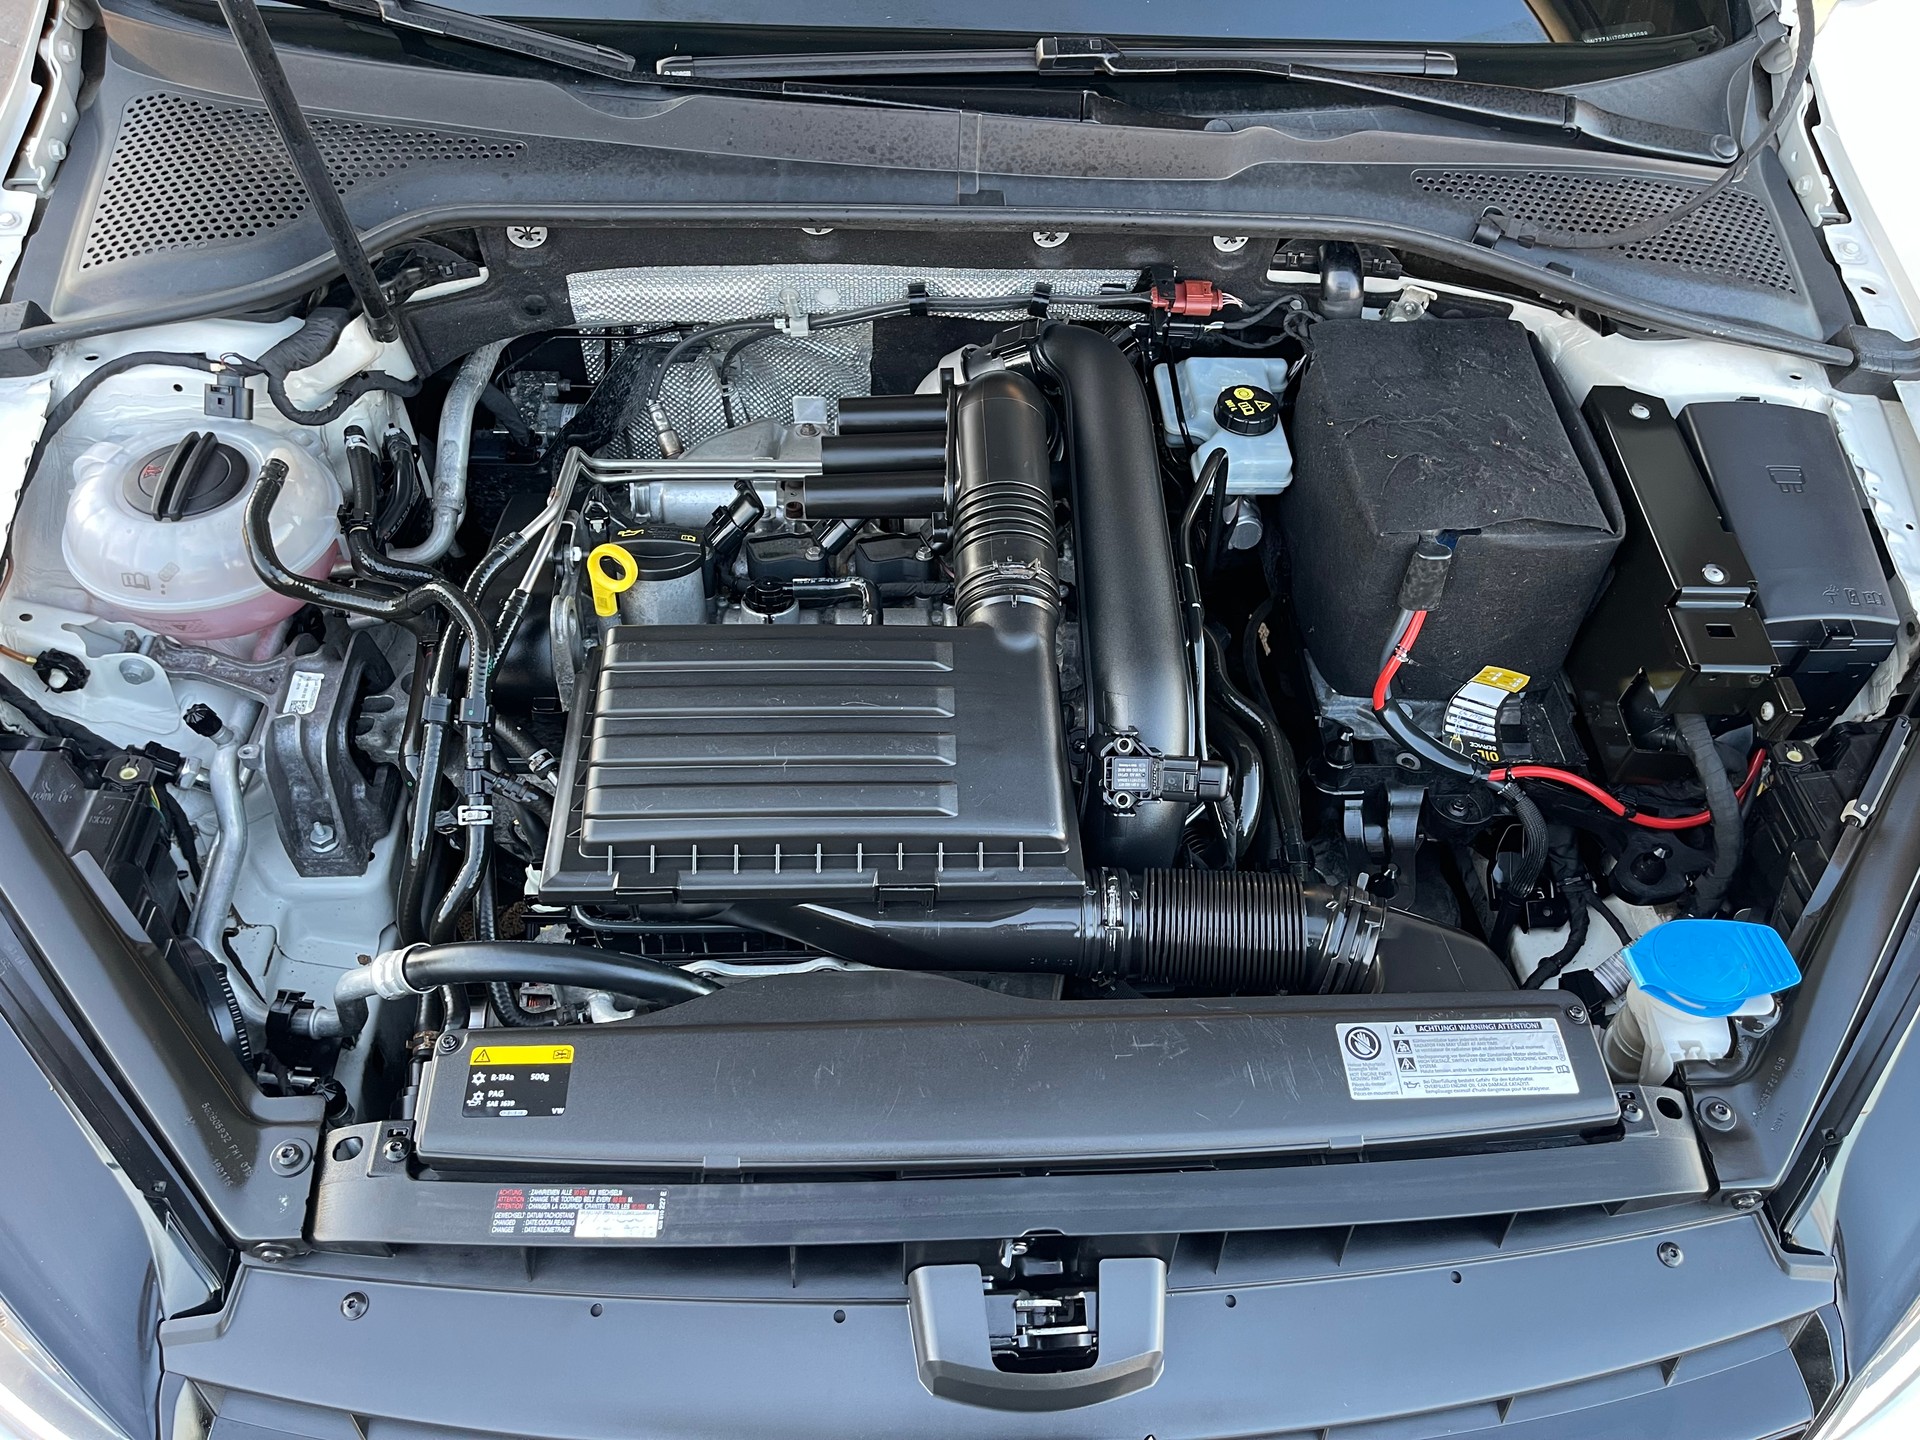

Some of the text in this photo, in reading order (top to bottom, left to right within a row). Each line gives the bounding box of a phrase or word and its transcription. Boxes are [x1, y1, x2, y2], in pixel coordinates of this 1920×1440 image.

[1469, 741, 1497, 751] SERVICE
[1477, 749, 1499, 762] OIL
[490, 1072, 550, 1082] R-134a 500g
